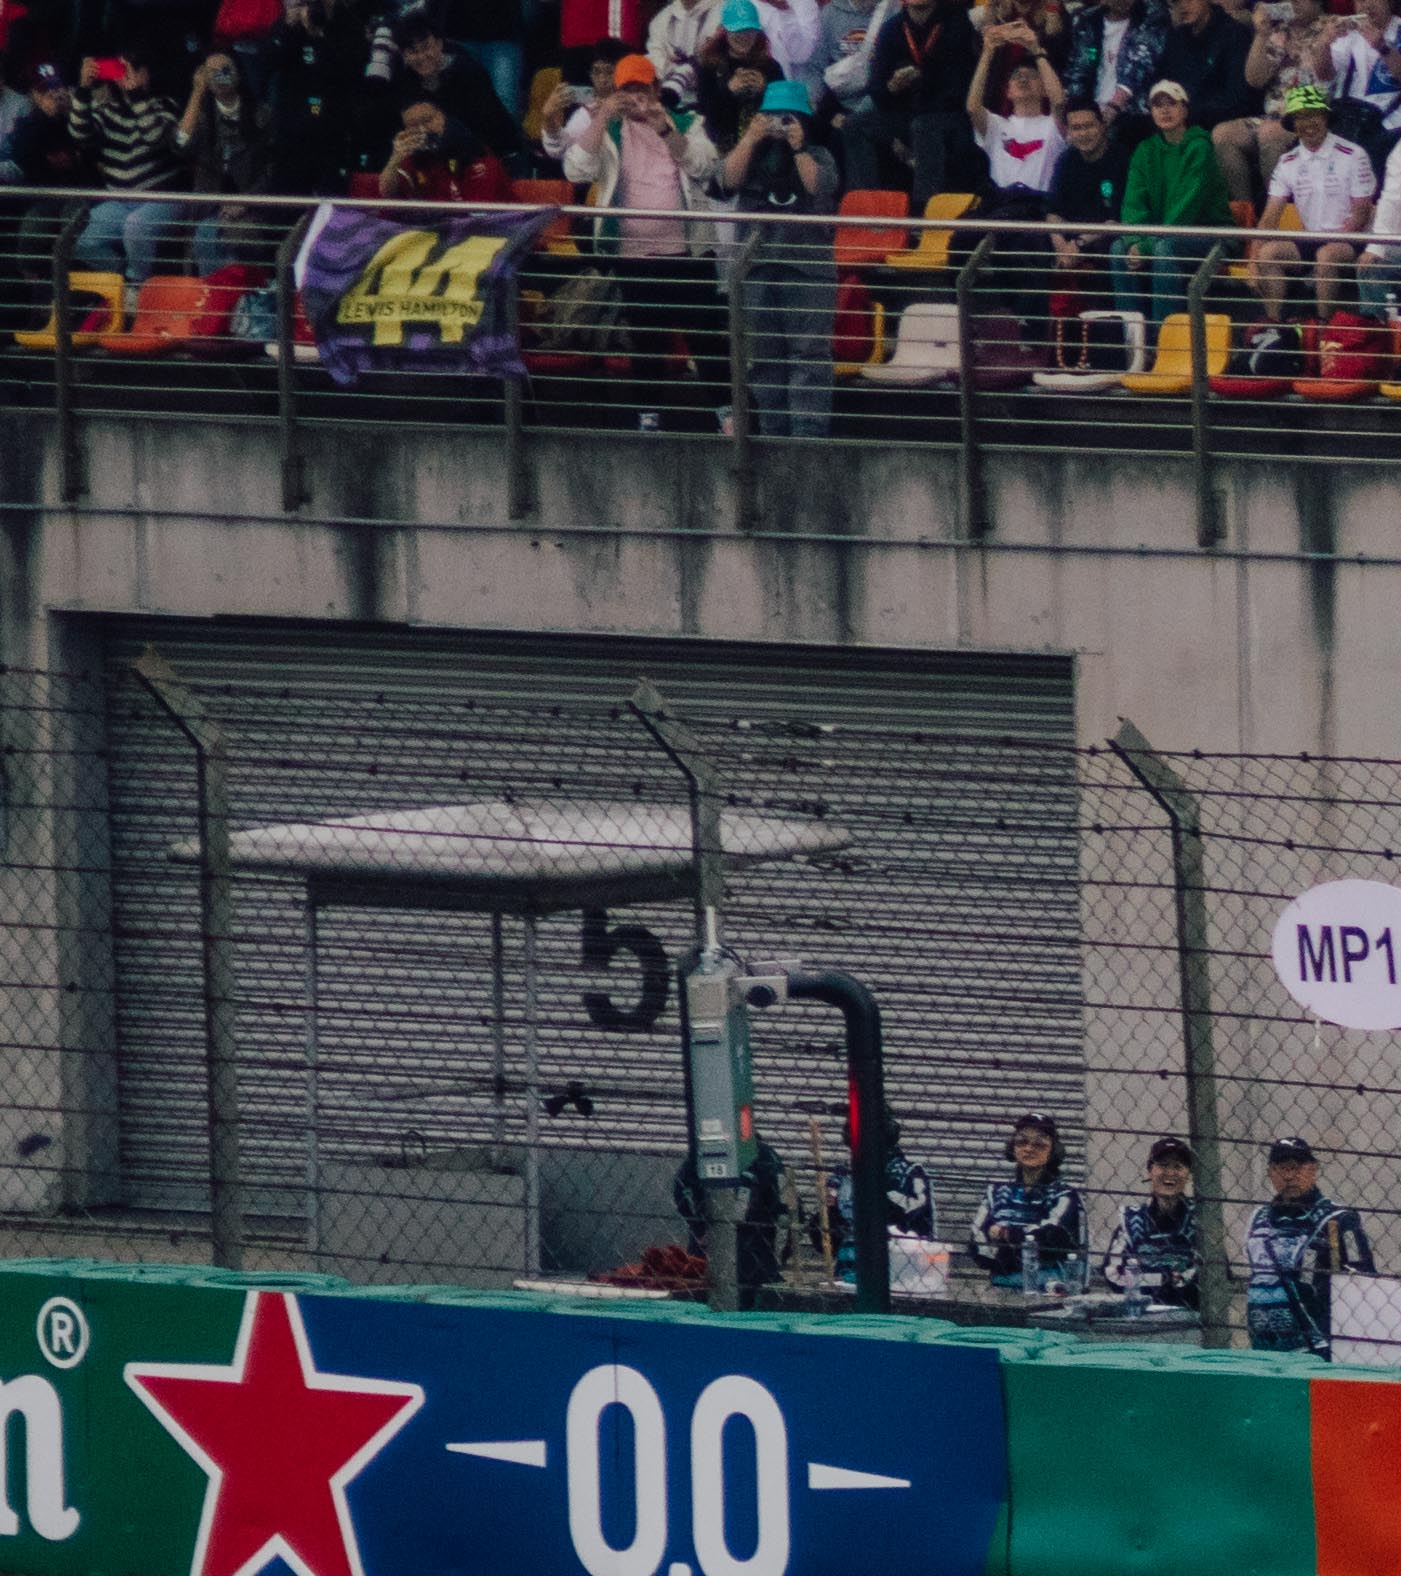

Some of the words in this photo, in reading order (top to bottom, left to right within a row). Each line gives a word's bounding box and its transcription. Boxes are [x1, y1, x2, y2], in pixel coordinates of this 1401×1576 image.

[337, 230, 508, 346] 44
[343, 301, 394, 320] LEWIS
[400, 299, 479, 318] HAMILTON
[582, 900, 668, 1033] 5
